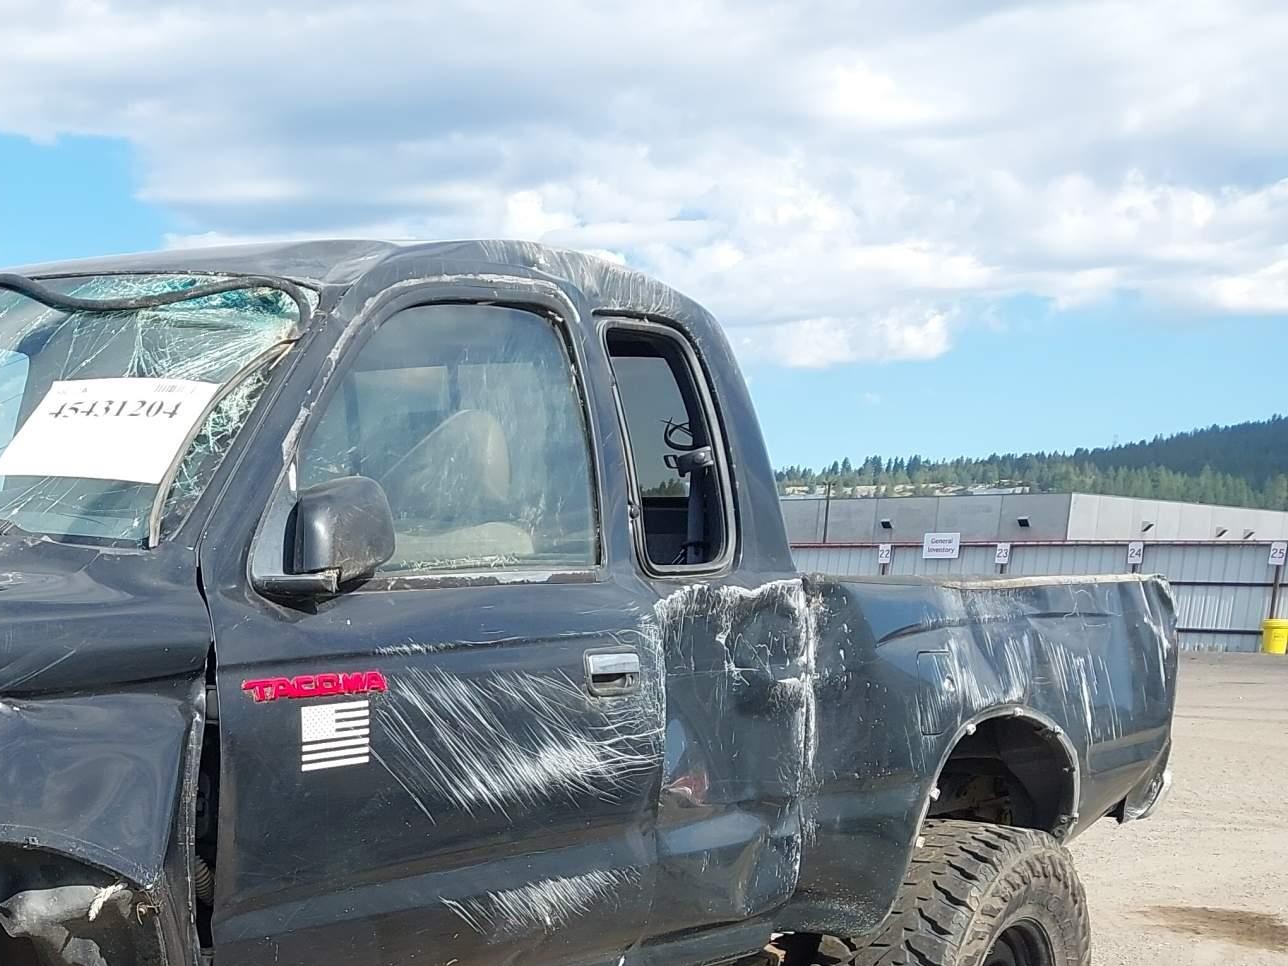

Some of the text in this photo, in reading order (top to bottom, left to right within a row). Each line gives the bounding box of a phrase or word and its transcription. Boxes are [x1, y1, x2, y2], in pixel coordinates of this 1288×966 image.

[49, 399, 183, 418] 45431204
[930, 537, 954, 545] General
[879, 549, 890, 559] 22
[927, 544, 955, 554] Inventory
[996, 549, 1009, 558] 23
[1129, 548, 1142, 558] 24
[1270, 548, 1285, 559] 25
[241, 669, 388, 703] TACOMA
